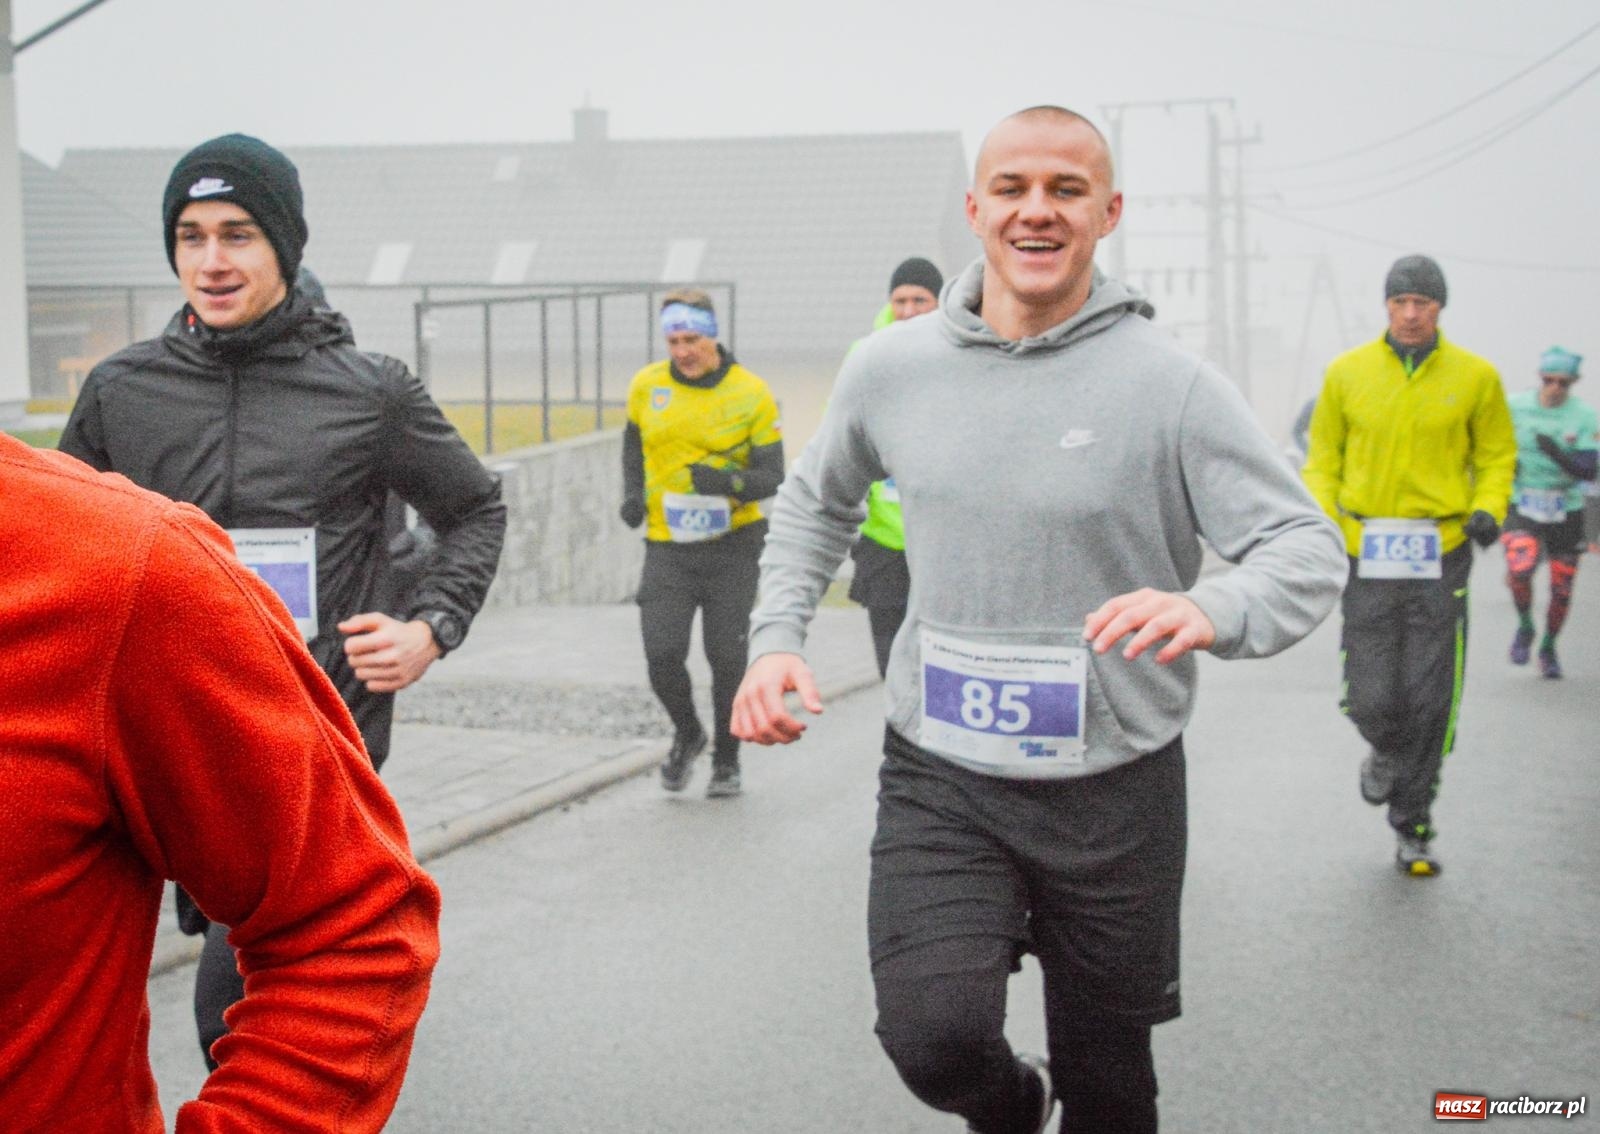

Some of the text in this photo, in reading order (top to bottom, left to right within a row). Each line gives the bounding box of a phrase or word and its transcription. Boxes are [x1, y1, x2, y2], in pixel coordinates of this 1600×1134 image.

[680, 510, 712, 532] 60
[1373, 535, 1426, 561] 168
[961, 680, 1031, 733] 85
